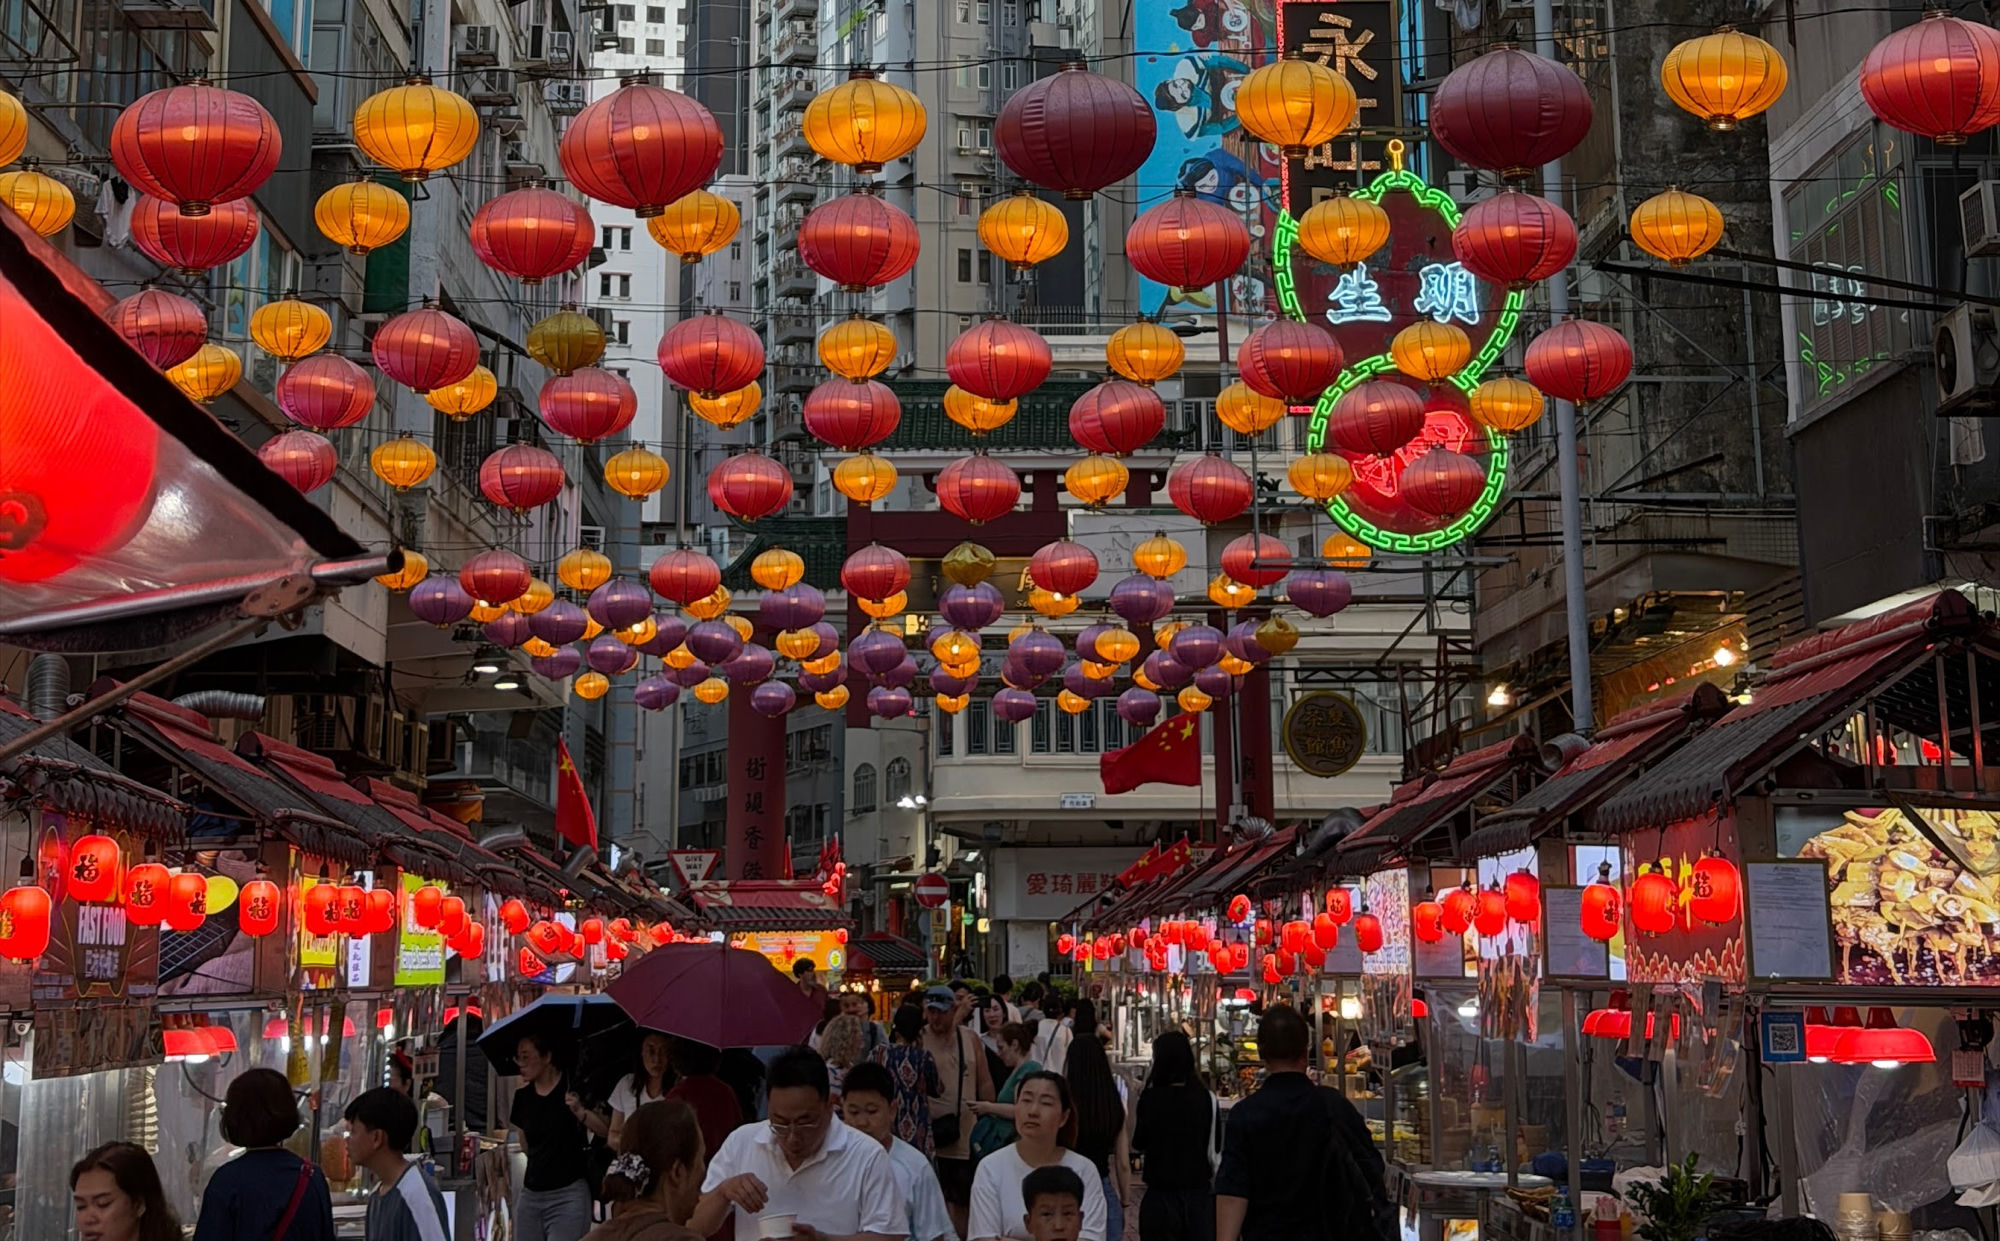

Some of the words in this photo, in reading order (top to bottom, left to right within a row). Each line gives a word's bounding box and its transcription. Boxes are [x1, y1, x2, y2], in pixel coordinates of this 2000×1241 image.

[74, 853, 100, 882] 福
[78, 905, 102, 945] FAST
[102, 906, 126, 946] FOOD
